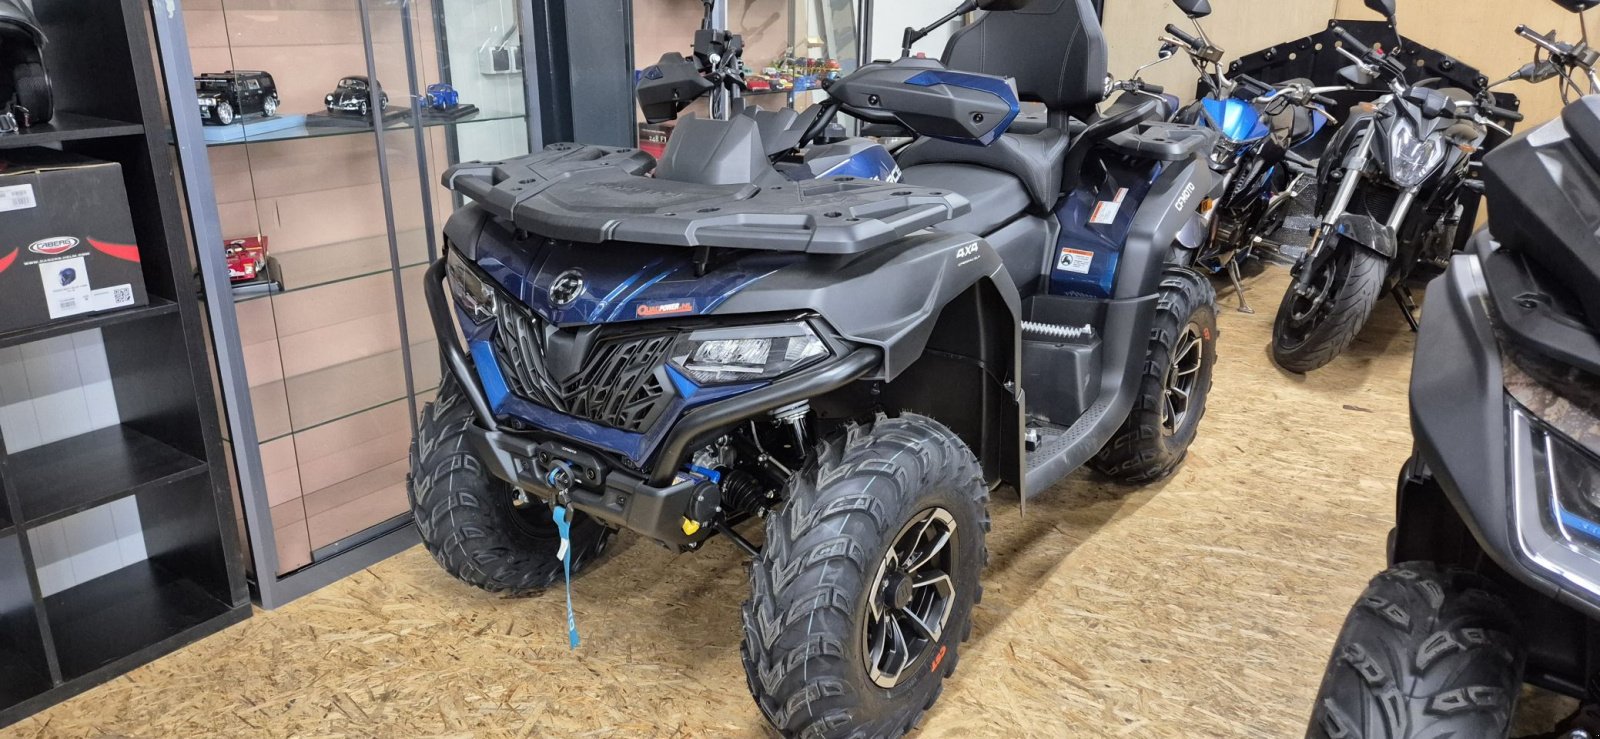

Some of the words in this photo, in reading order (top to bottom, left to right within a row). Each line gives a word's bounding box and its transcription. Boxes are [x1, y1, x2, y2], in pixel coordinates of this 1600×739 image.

[1175, 182, 1195, 211] CFMOTO
[36, 240, 71, 249] CABERG
[931, 645, 946, 672] CST
